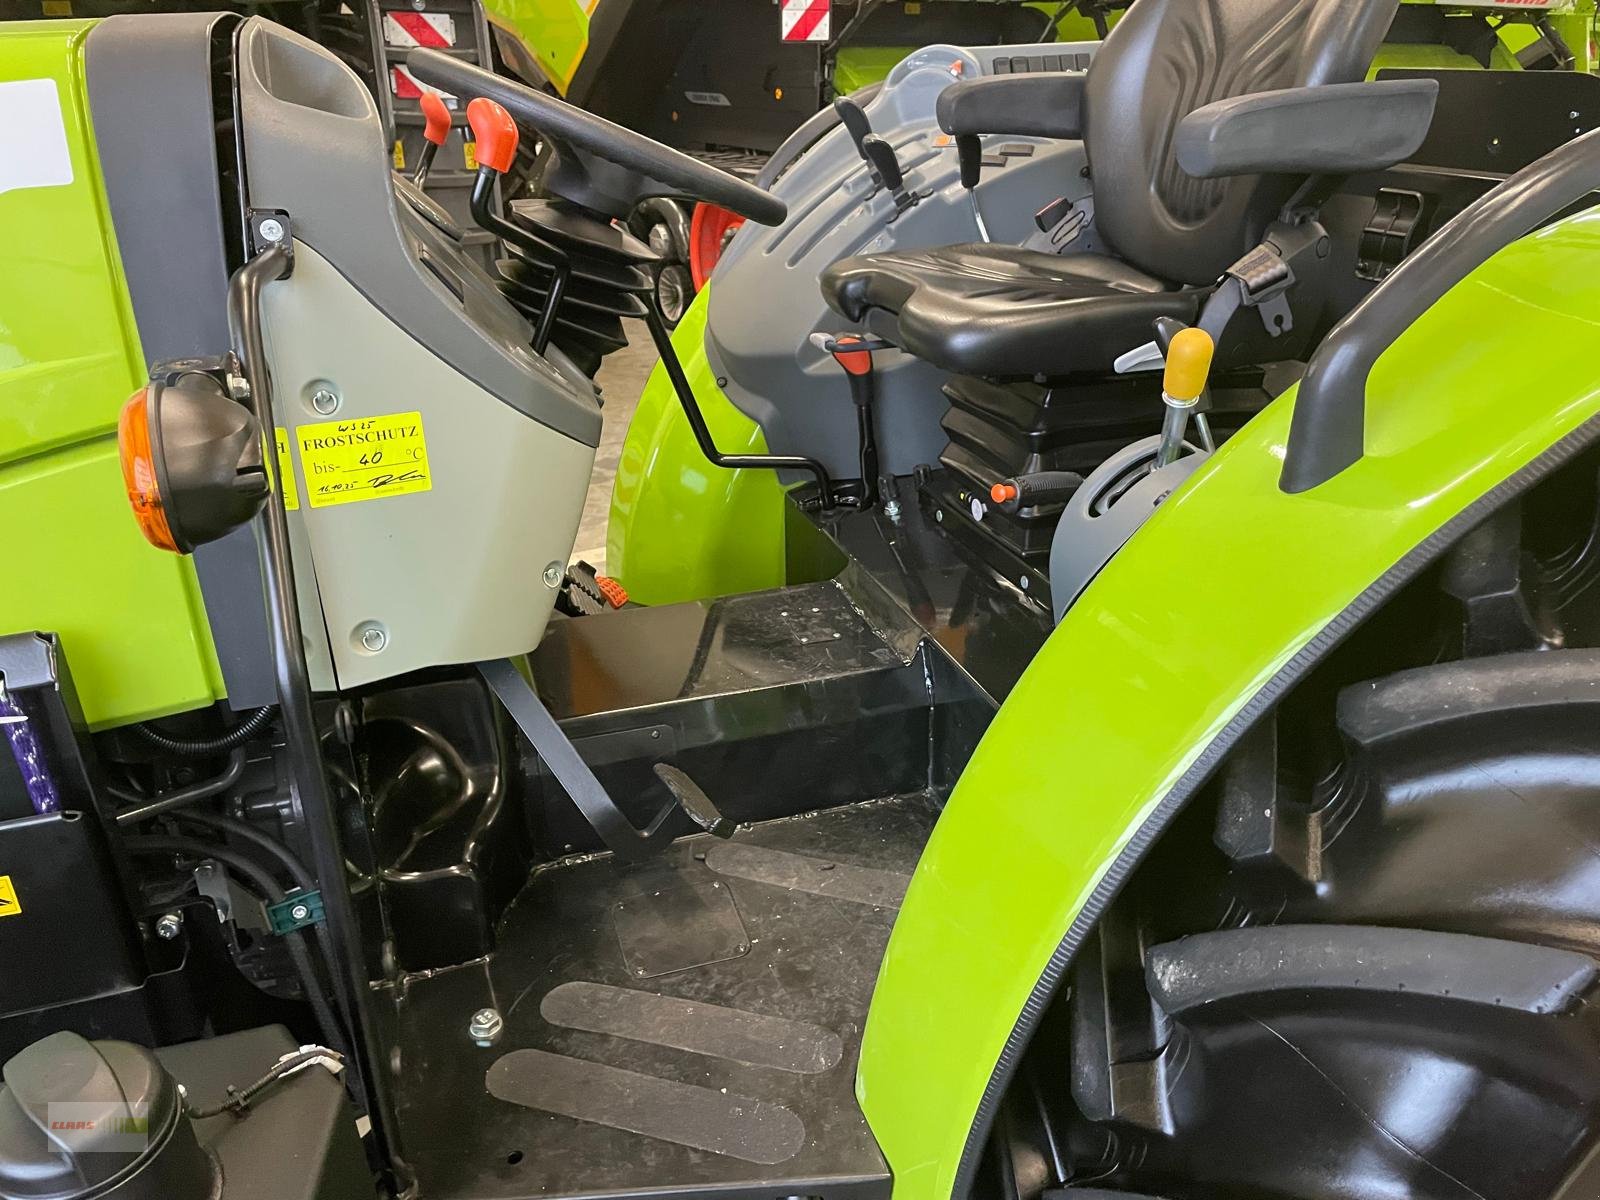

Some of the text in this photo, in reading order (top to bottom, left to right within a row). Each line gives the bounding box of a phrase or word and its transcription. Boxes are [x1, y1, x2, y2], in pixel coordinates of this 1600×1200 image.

[303, 425, 419, 451] FROSTSCHUTZ
[313, 447, 423, 475] bis- 40 °C
